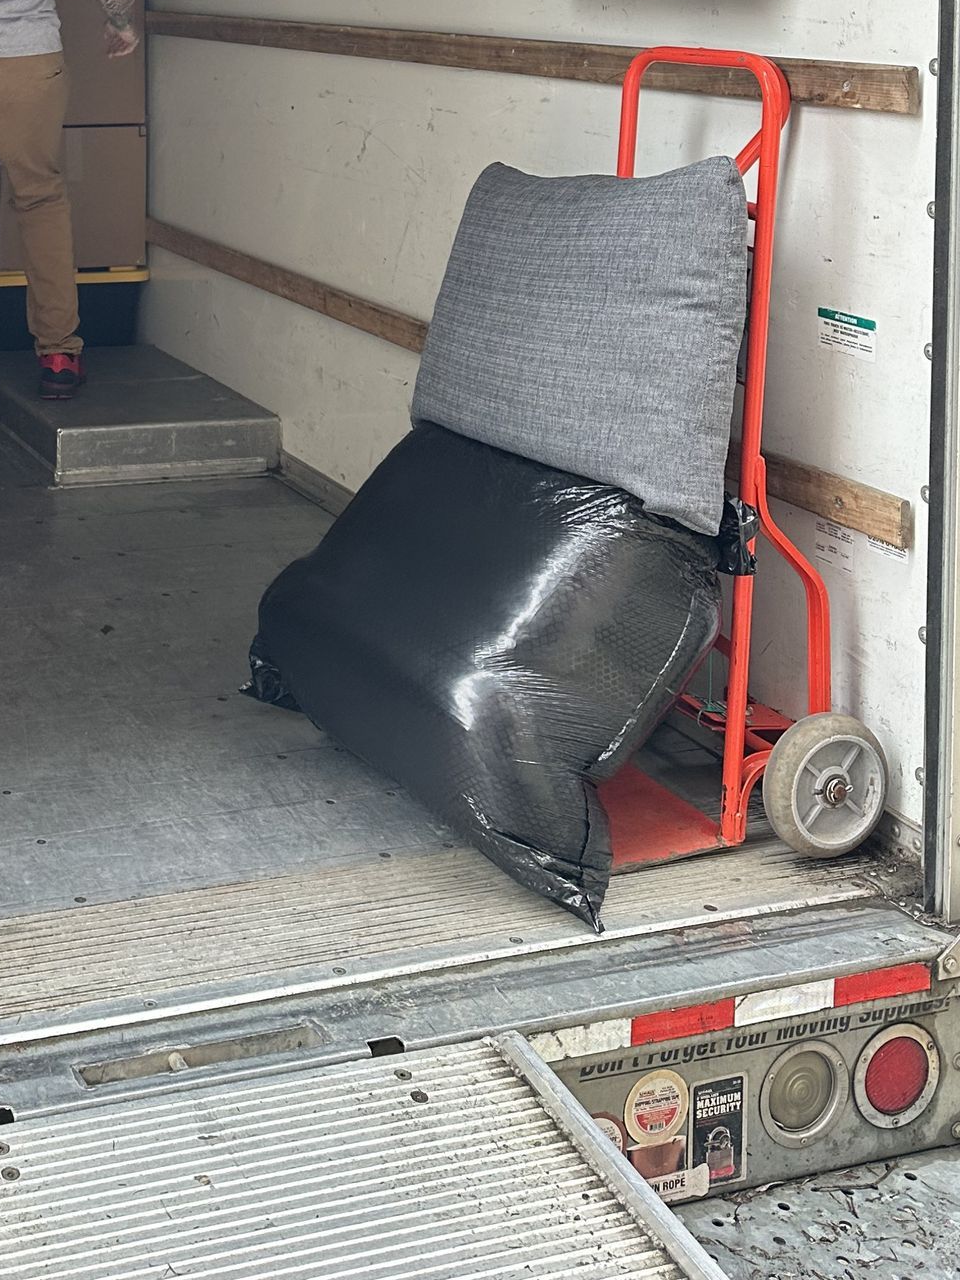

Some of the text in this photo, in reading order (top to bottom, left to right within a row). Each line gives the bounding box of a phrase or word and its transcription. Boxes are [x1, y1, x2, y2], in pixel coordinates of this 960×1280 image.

[834, 314, 858, 324] ATTENTION
[696, 1092, 741, 1110] MAXIMUM
[696, 1101, 742, 1119] SECURITY
[662, 1177, 686, 1191] ROPE
